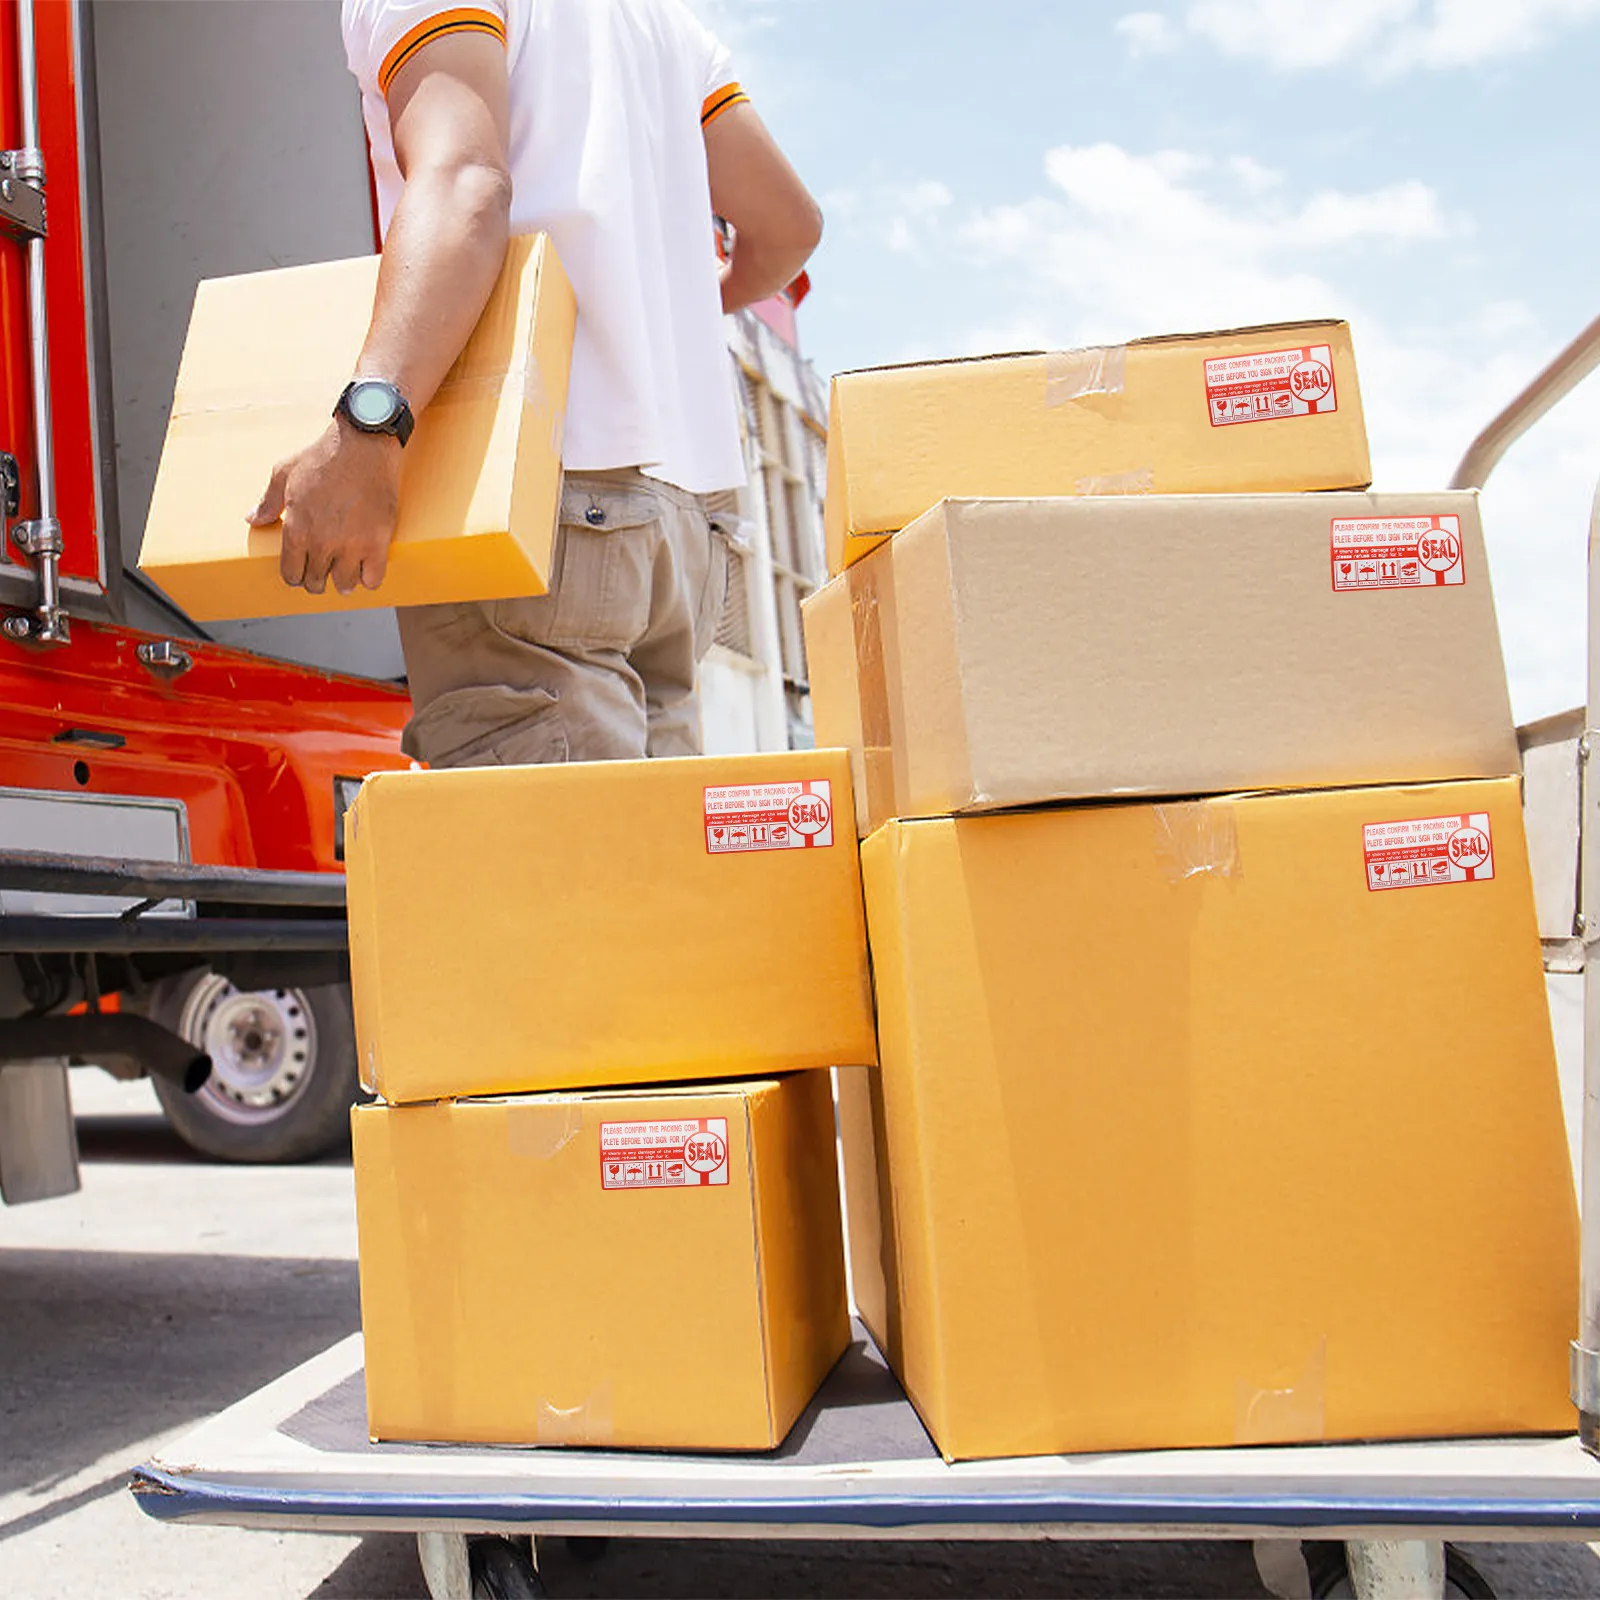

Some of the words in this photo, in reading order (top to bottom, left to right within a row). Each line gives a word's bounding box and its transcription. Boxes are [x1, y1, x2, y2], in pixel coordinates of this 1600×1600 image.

[1229, 360, 1250, 368] CONFIRM
[1265, 356, 1286, 364] PACKING
[1226, 371, 1246, 380] BEFORE
[1294, 370, 1327, 390] SEAL
[1422, 539, 1455, 559] SEAL
[725, 801, 744, 809] BEFORE
[792, 804, 825, 823] SEAL
[1367, 828, 1385, 836] PLEASE
[1452, 837, 1485, 857] SEAL
[688, 1142, 721, 1161] SEAL
